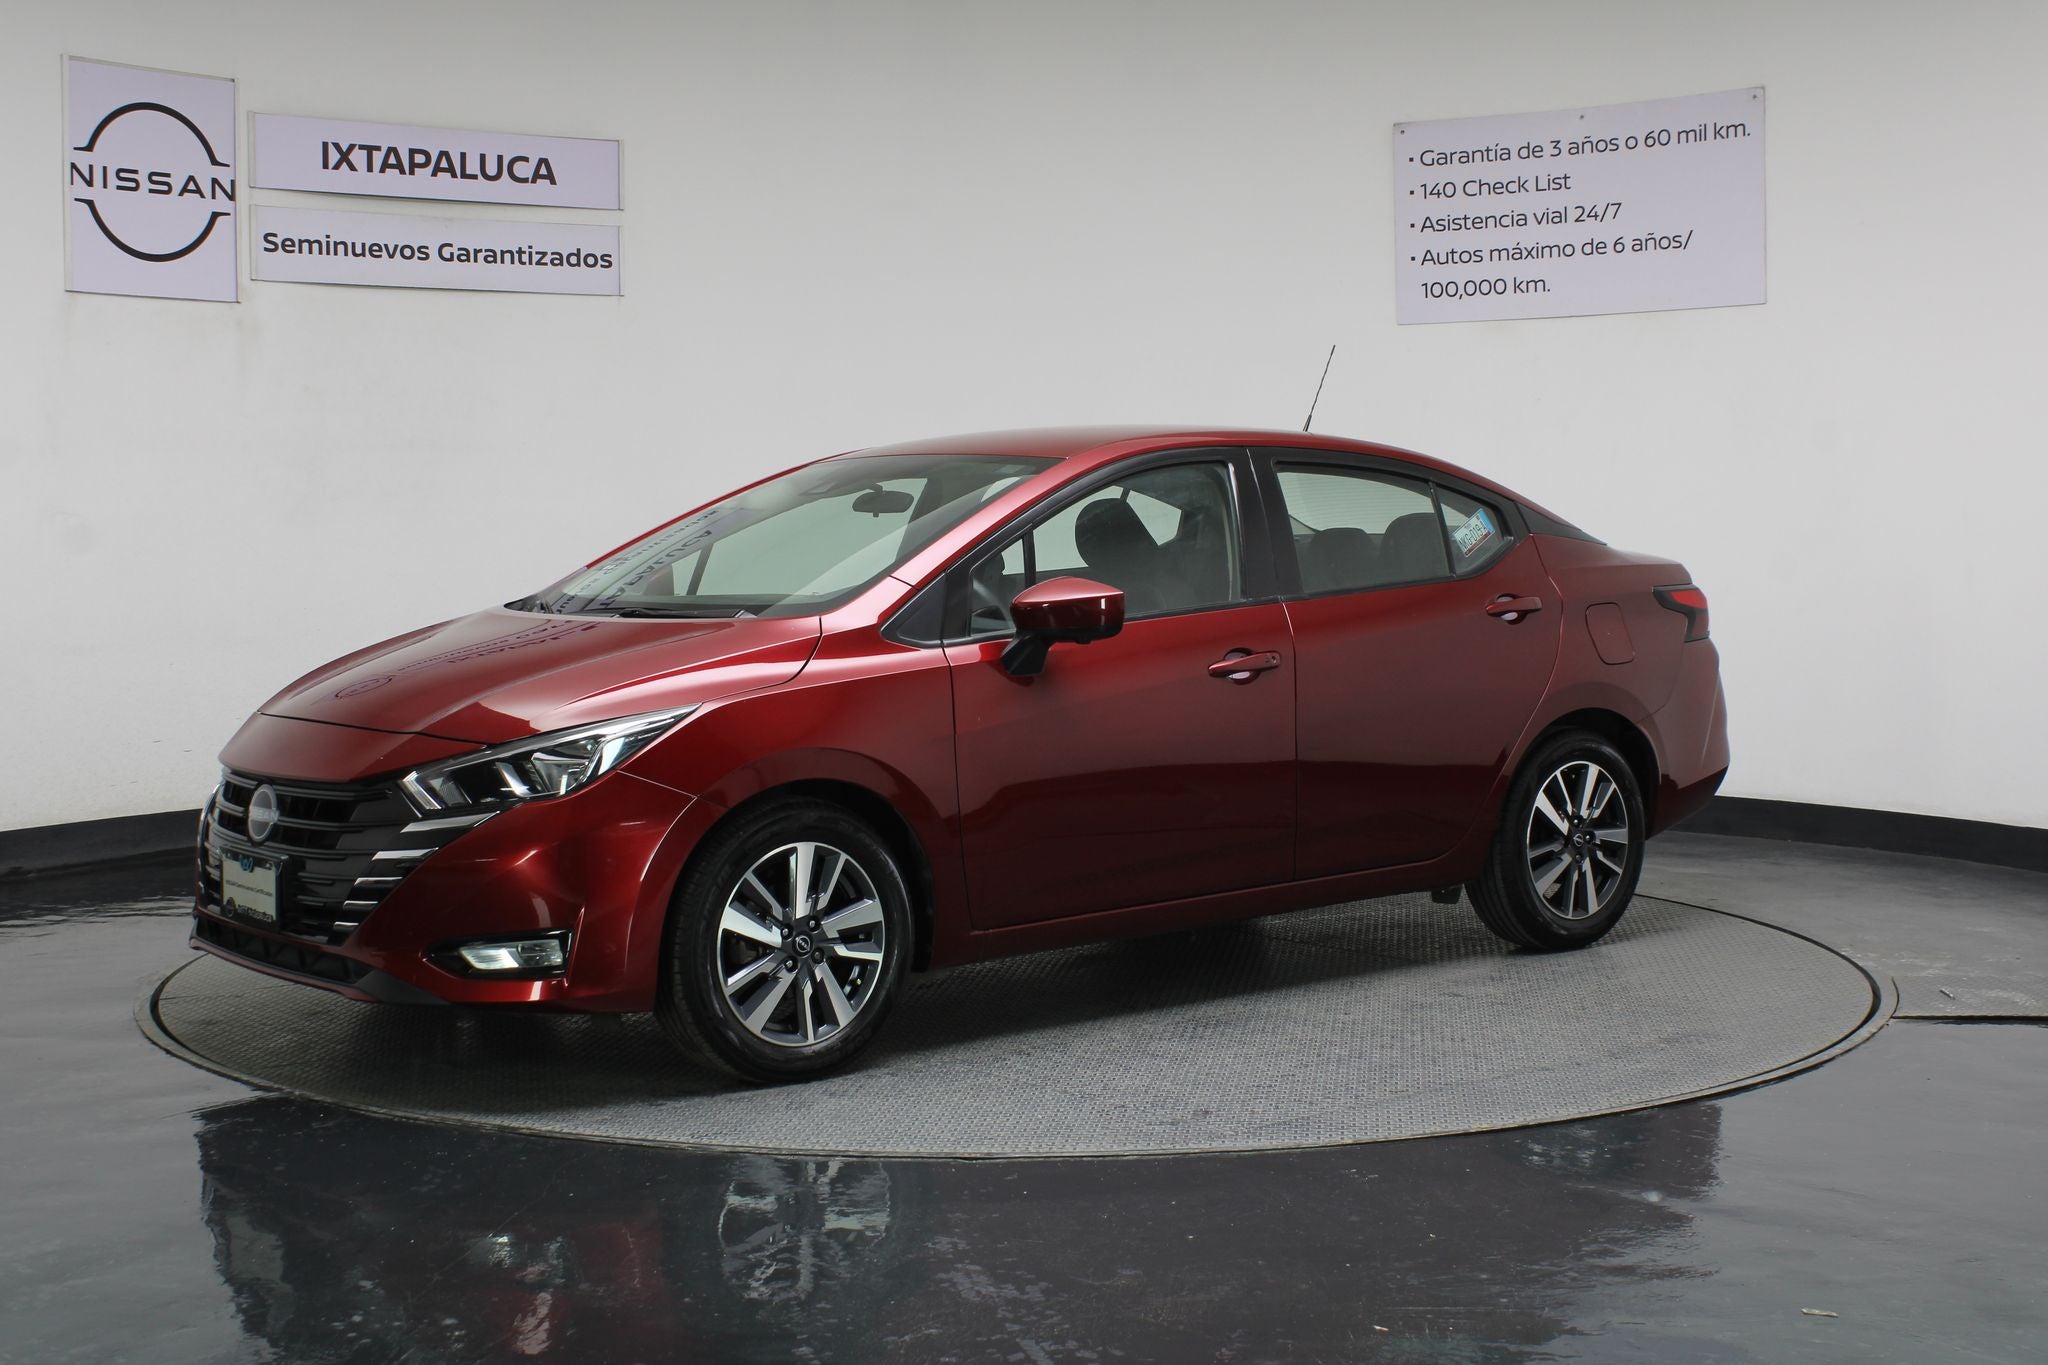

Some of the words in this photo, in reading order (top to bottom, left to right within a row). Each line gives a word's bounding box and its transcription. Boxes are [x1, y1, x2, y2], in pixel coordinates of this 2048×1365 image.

[1419, 142, 1512, 167] Garantía
[1517, 141, 1544, 160] de
[1549, 139, 1562, 158] 3
[1567, 135, 1620, 156] años
[1624, 135, 1639, 151] o
[1643, 128, 1672, 148] 60
[1677, 123, 1707, 145] mil
[1713, 121, 1751, 141] km.
[70, 160, 236, 202] NISSAN
[321, 140, 558, 186] IXTAPALUCA
[1419, 181, 1457, 200] 140
[1462, 175, 1530, 197] Check
[1535, 172, 1572, 192] List
[1420, 209, 1528, 233] Asistencia
[1532, 205, 1568, 226] vial
[1573, 202, 1623, 223] 24/7
[262, 232, 431, 262] Seminuevos
[437, 242, 613, 269] Garantizados
[1420, 247, 1484, 267] Autos
[1489, 241, 1576, 263] máximo
[1580, 237, 1608, 256] de
[1612, 236, 1626, 254] 6
[1631, 229, 1694, 253] años/
[1420, 278, 1508, 301] 100,000
[1513, 276, 1551, 294] km.
